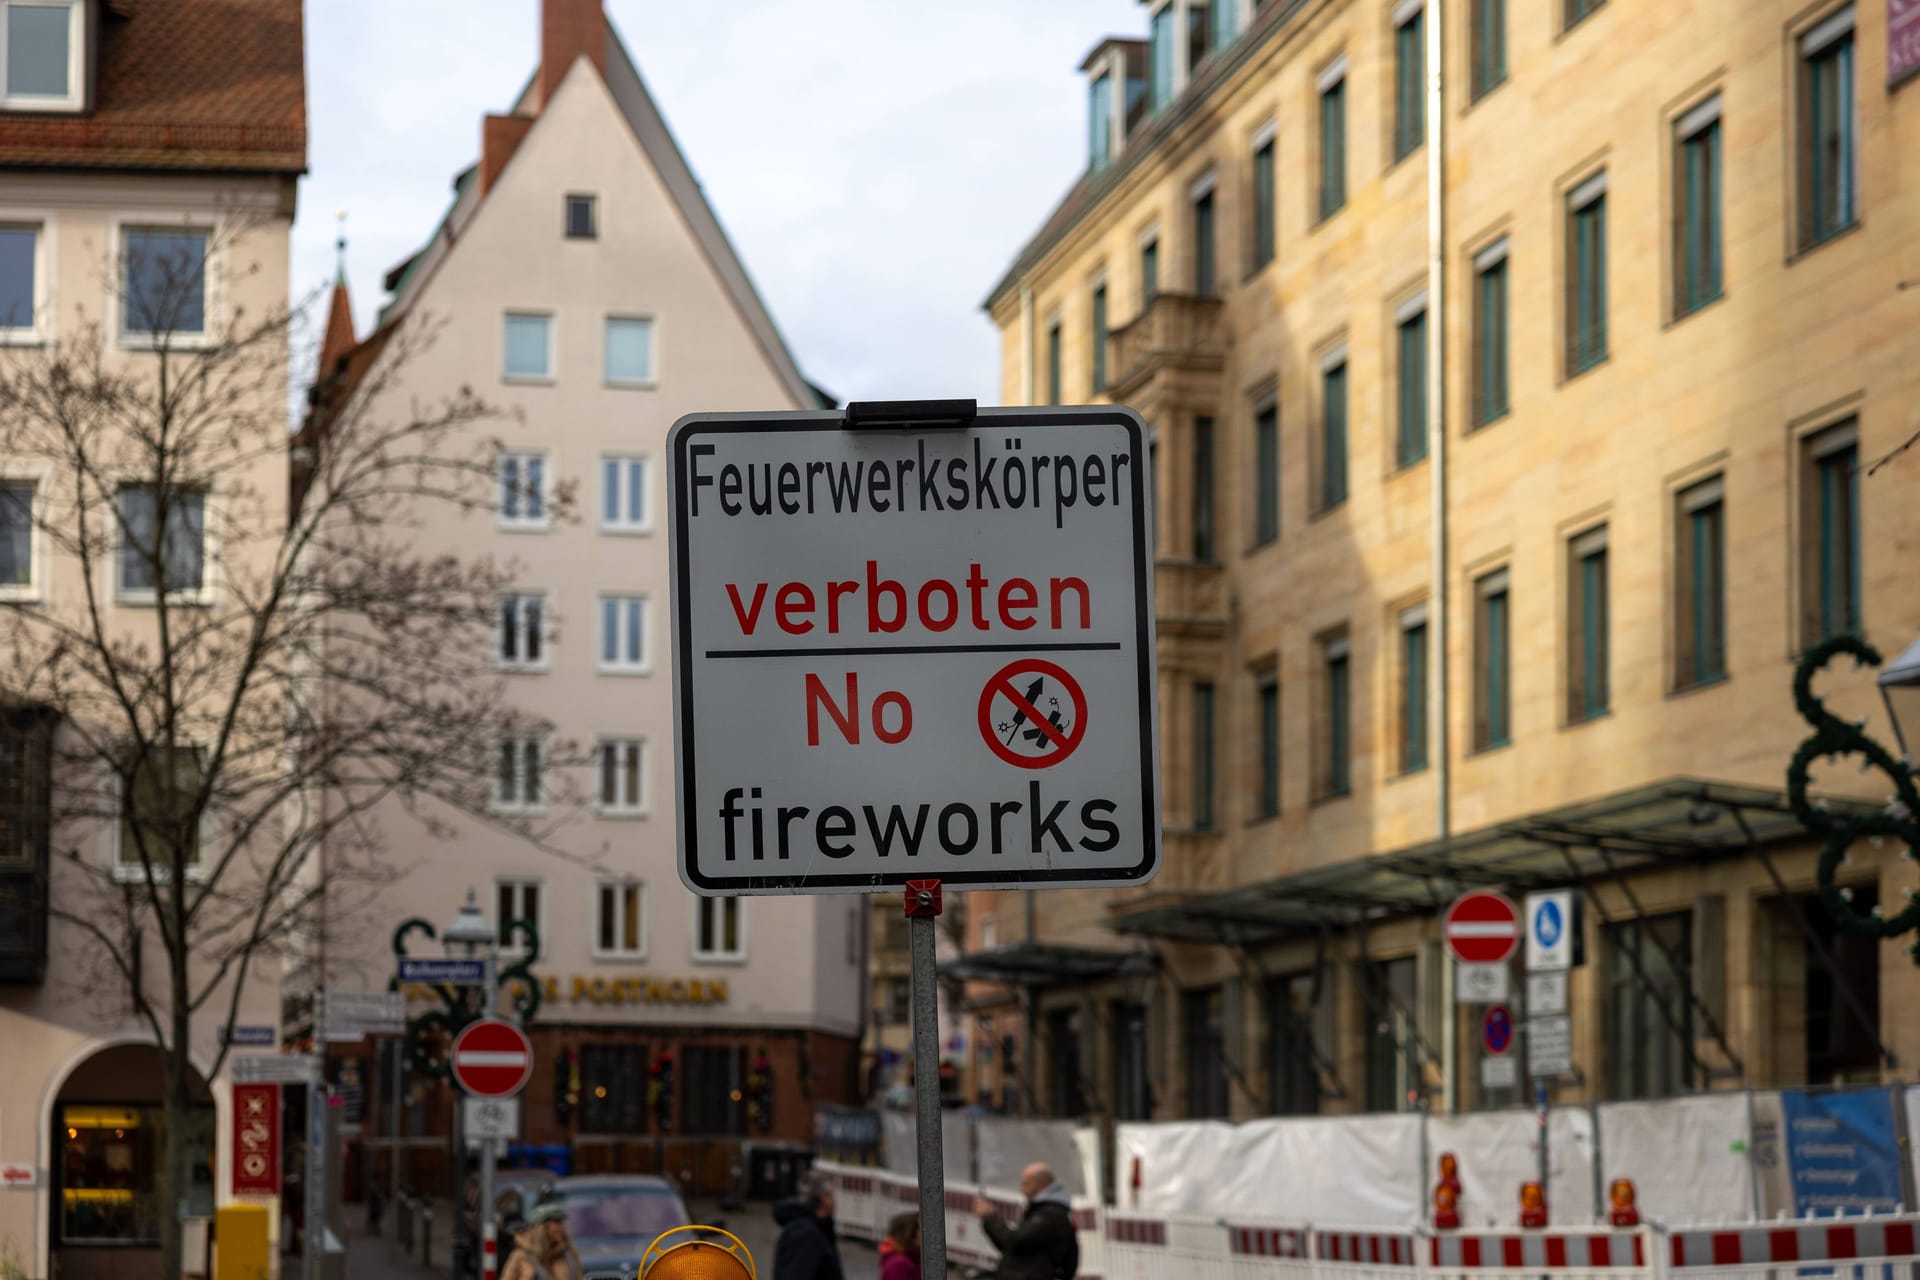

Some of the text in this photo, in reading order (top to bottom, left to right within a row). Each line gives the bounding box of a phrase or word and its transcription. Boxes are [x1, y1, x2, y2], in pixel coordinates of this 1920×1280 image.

[689, 437, 1130, 529] Feuerwerkskörper
[725, 559, 1091, 636] verboten
[805, 671, 913, 747] No
[719, 780, 1121, 862] fireworks
[573, 976, 728, 1005] POSTHORN
